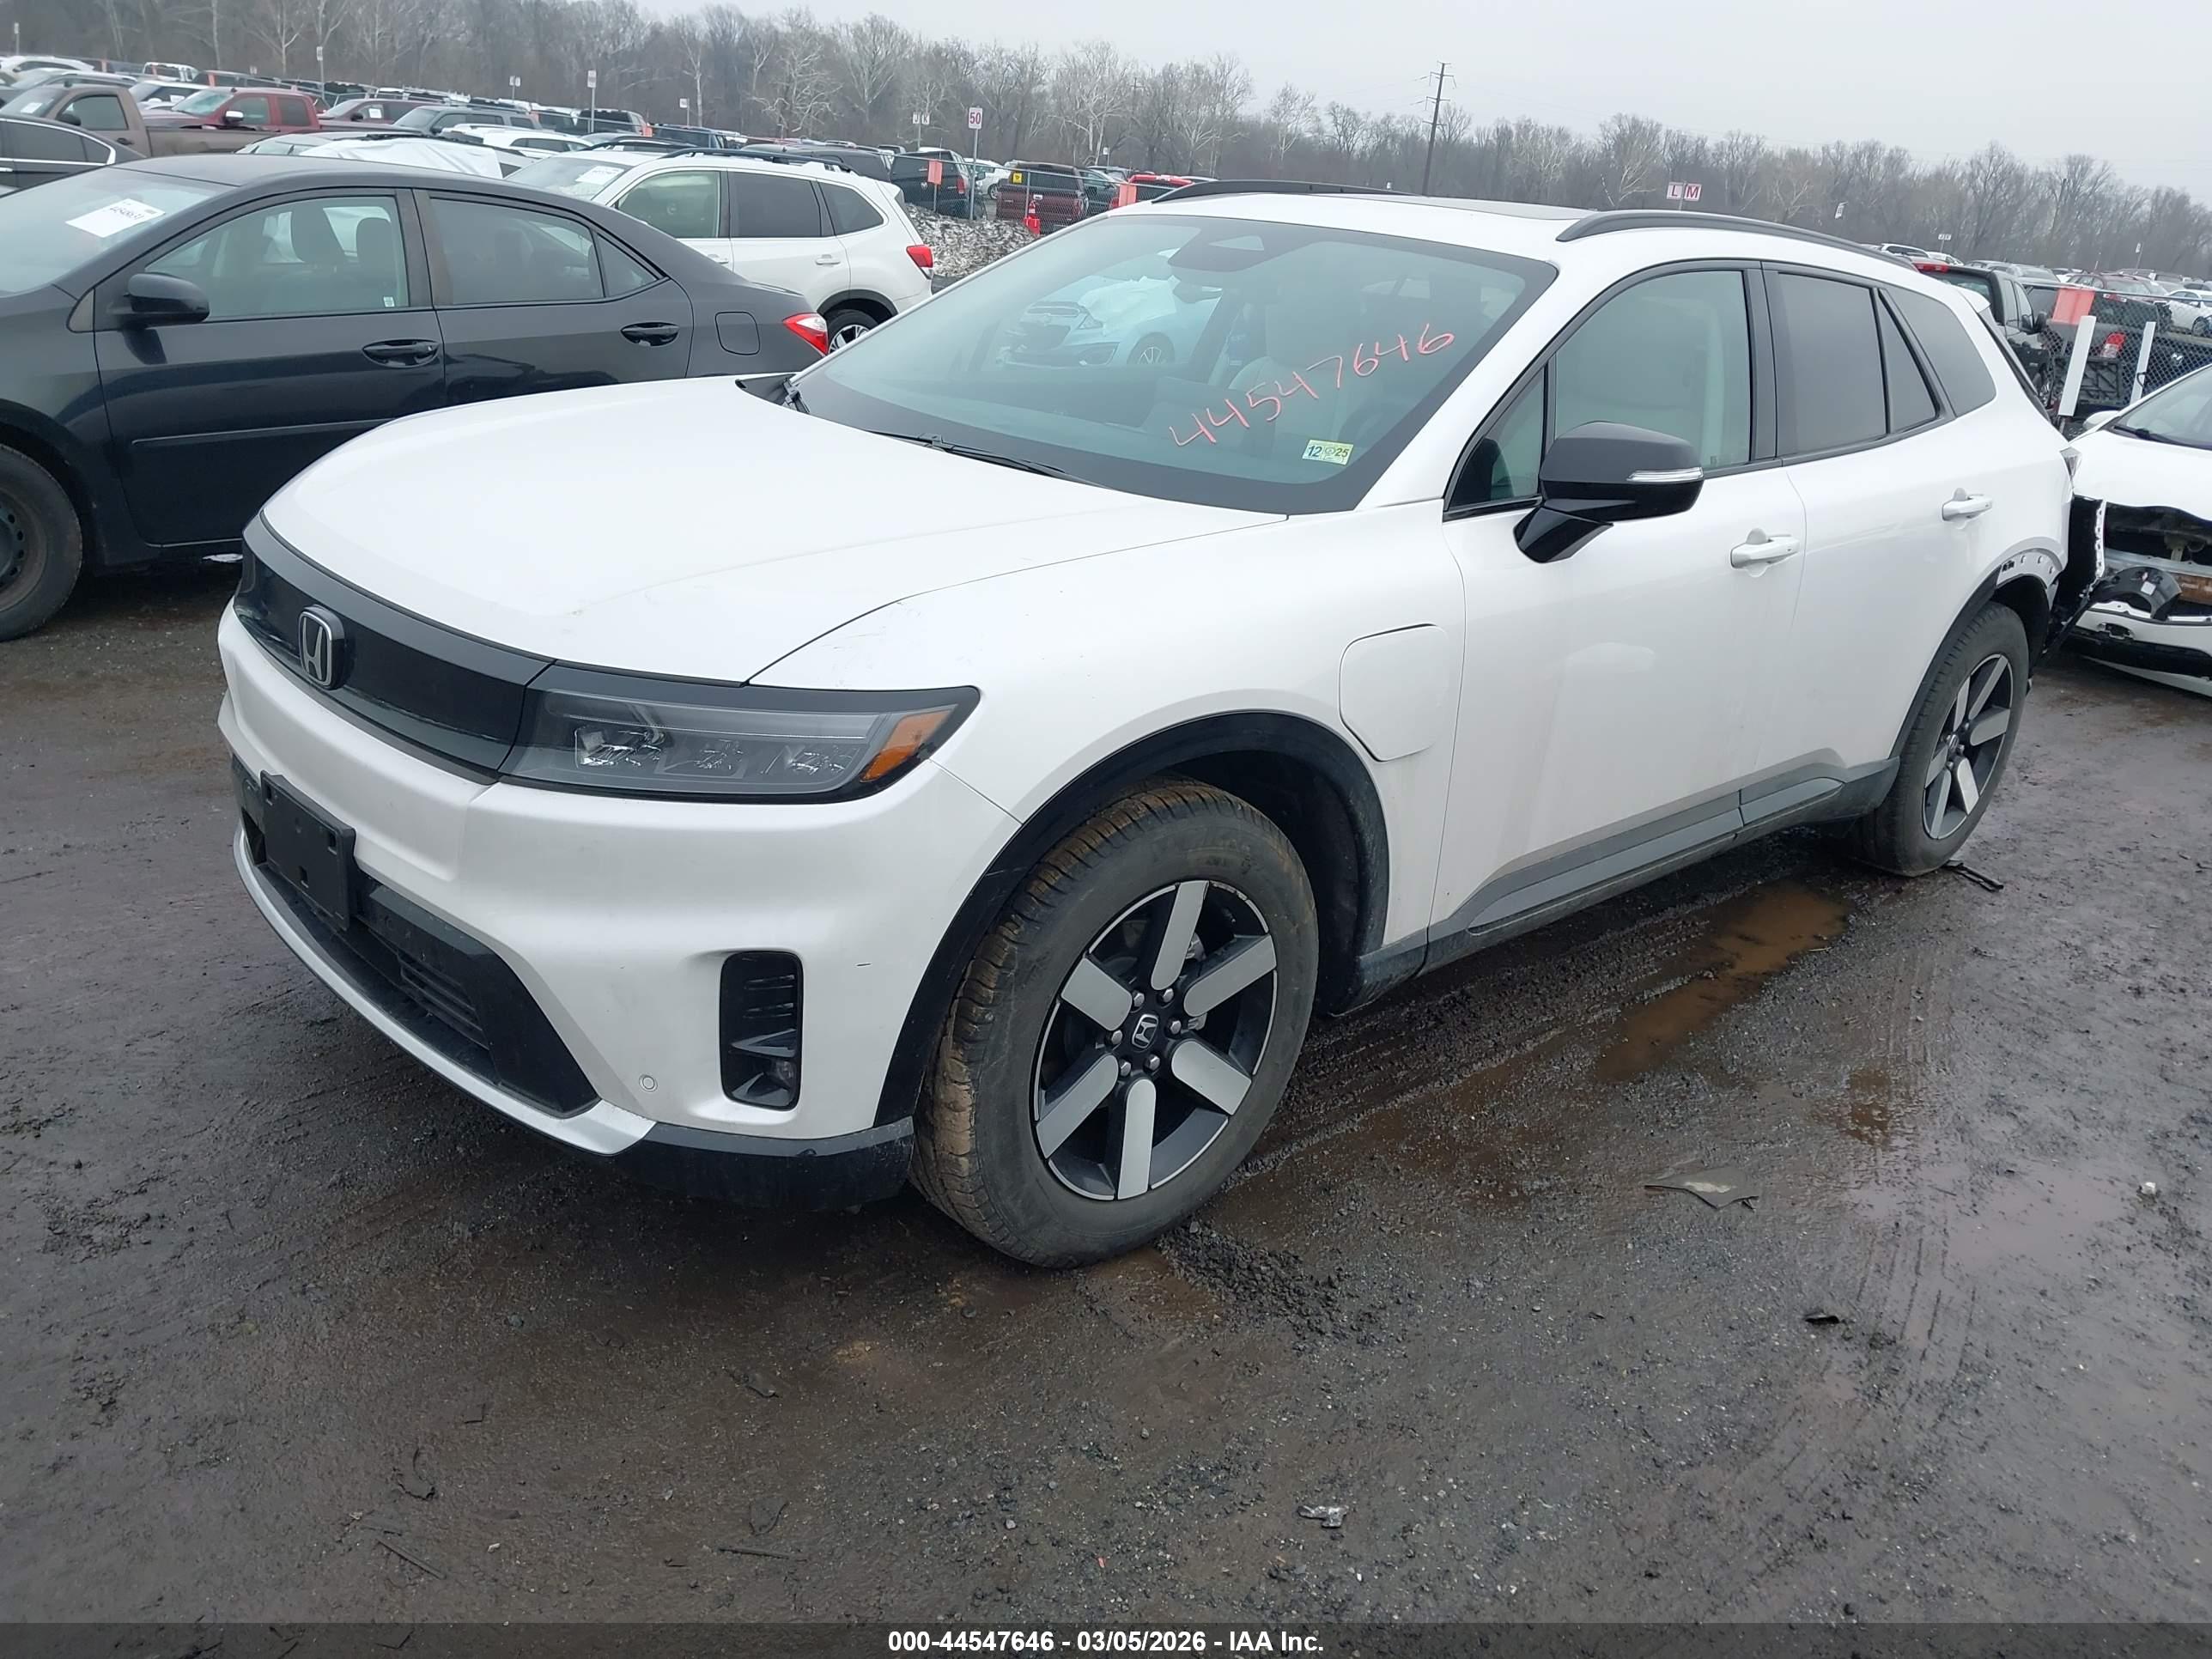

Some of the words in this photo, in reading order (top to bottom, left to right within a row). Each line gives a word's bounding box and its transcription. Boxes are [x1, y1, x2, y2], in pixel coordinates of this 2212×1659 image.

[969, 112, 981, 125] 50
[1671, 185, 1678, 197] L
[1686, 186, 1699, 198] M
[1169, 323, 1455, 447] 44547646
[1308, 445, 1322, 458] 12
[1334, 447, 1350, 458] 25
